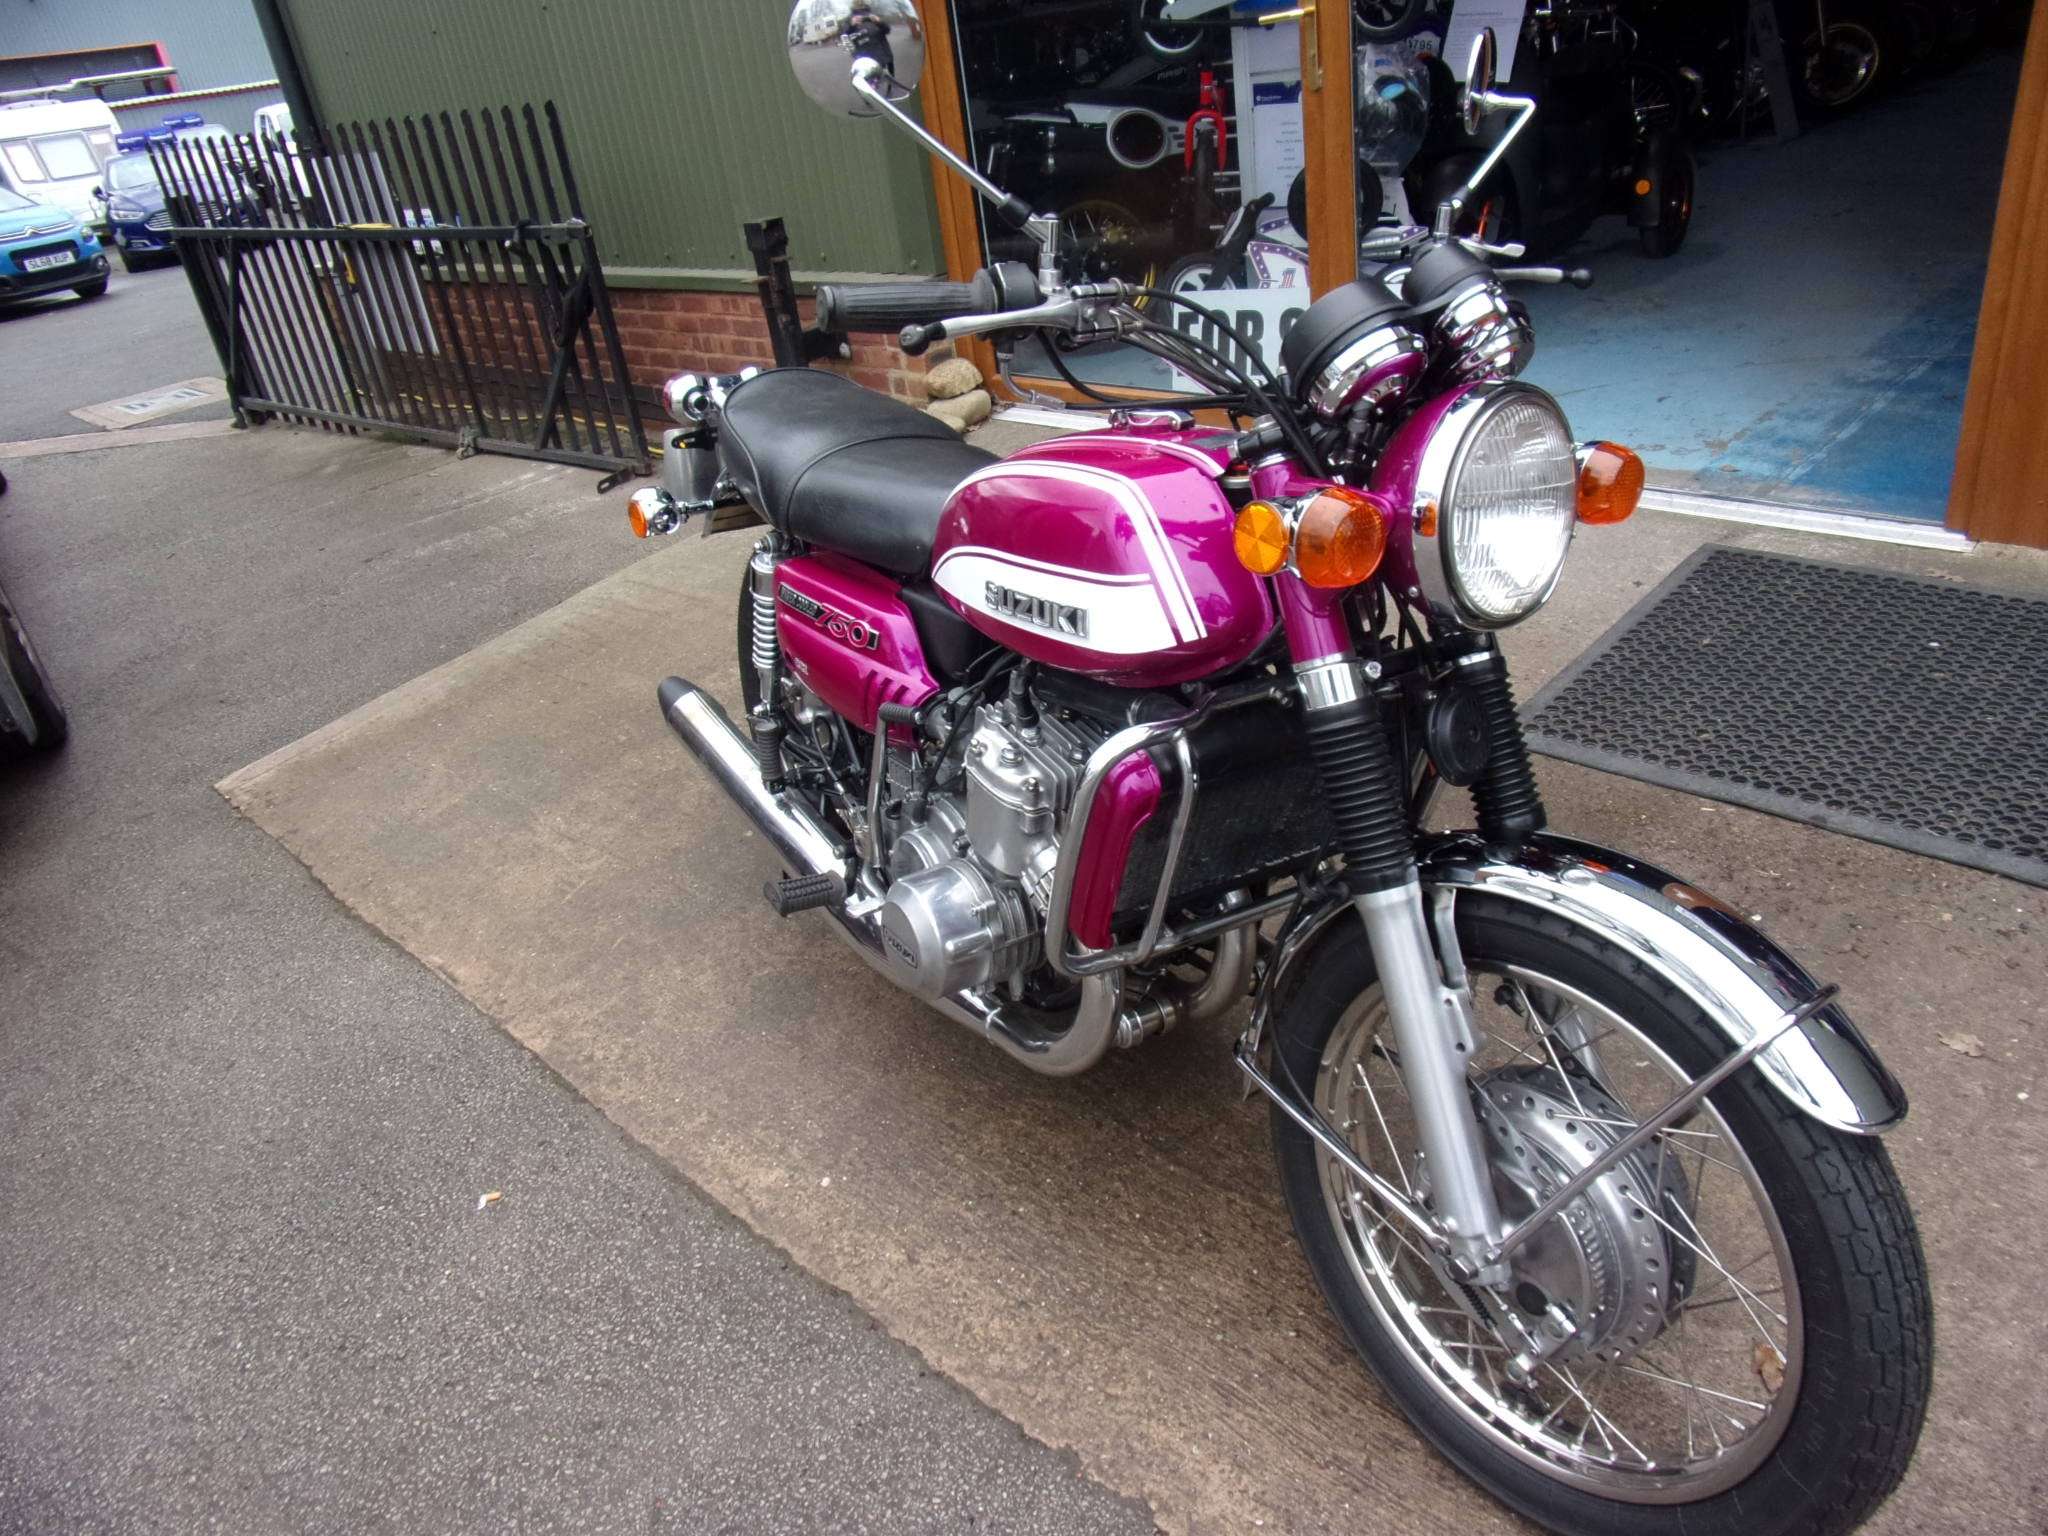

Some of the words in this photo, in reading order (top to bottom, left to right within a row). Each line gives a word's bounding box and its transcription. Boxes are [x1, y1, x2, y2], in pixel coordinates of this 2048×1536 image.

[1178, 308, 1265, 377] FOR
[815, 602, 870, 648] 750
[984, 580, 1089, 639] SUZUKI
